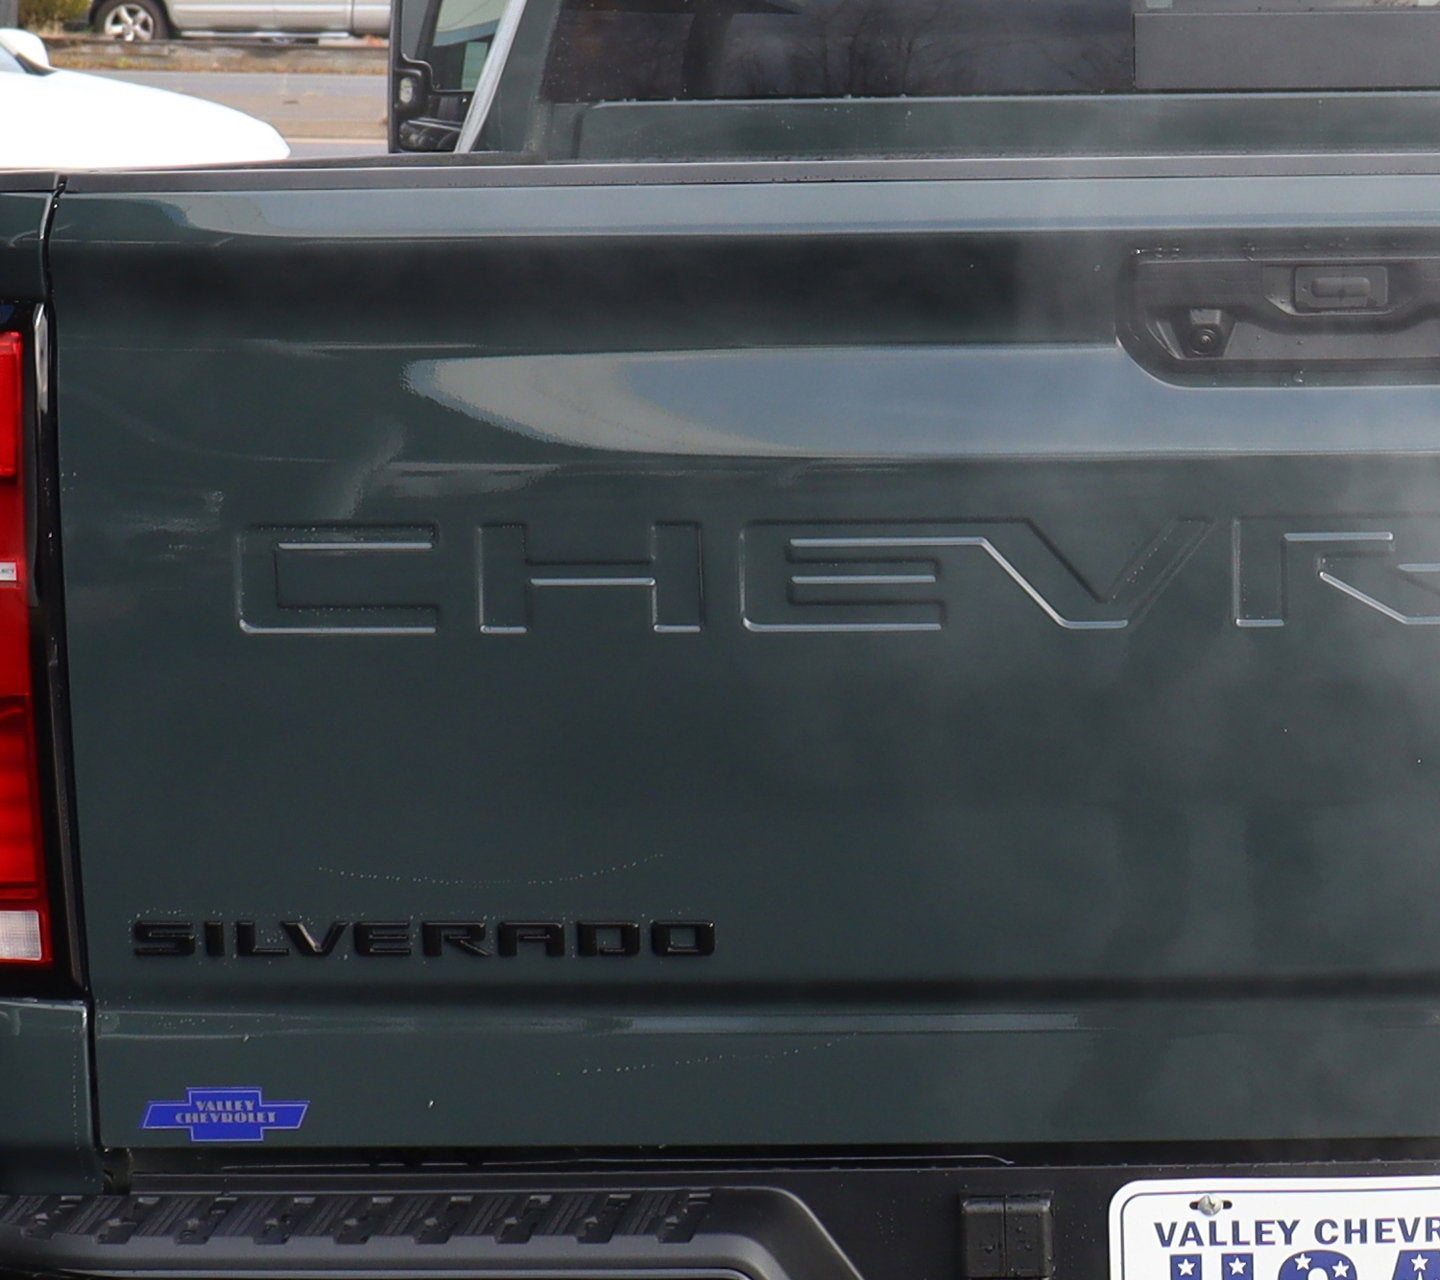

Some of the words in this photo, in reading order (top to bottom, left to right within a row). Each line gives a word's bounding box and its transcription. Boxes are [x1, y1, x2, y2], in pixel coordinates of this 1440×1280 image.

[133, 920, 716, 957] SILVERADO
[195, 1100, 255, 1111] VALLEY
[174, 1111, 276, 1123] CHEVROLET
[1153, 1219, 1301, 1248] VALLEY
